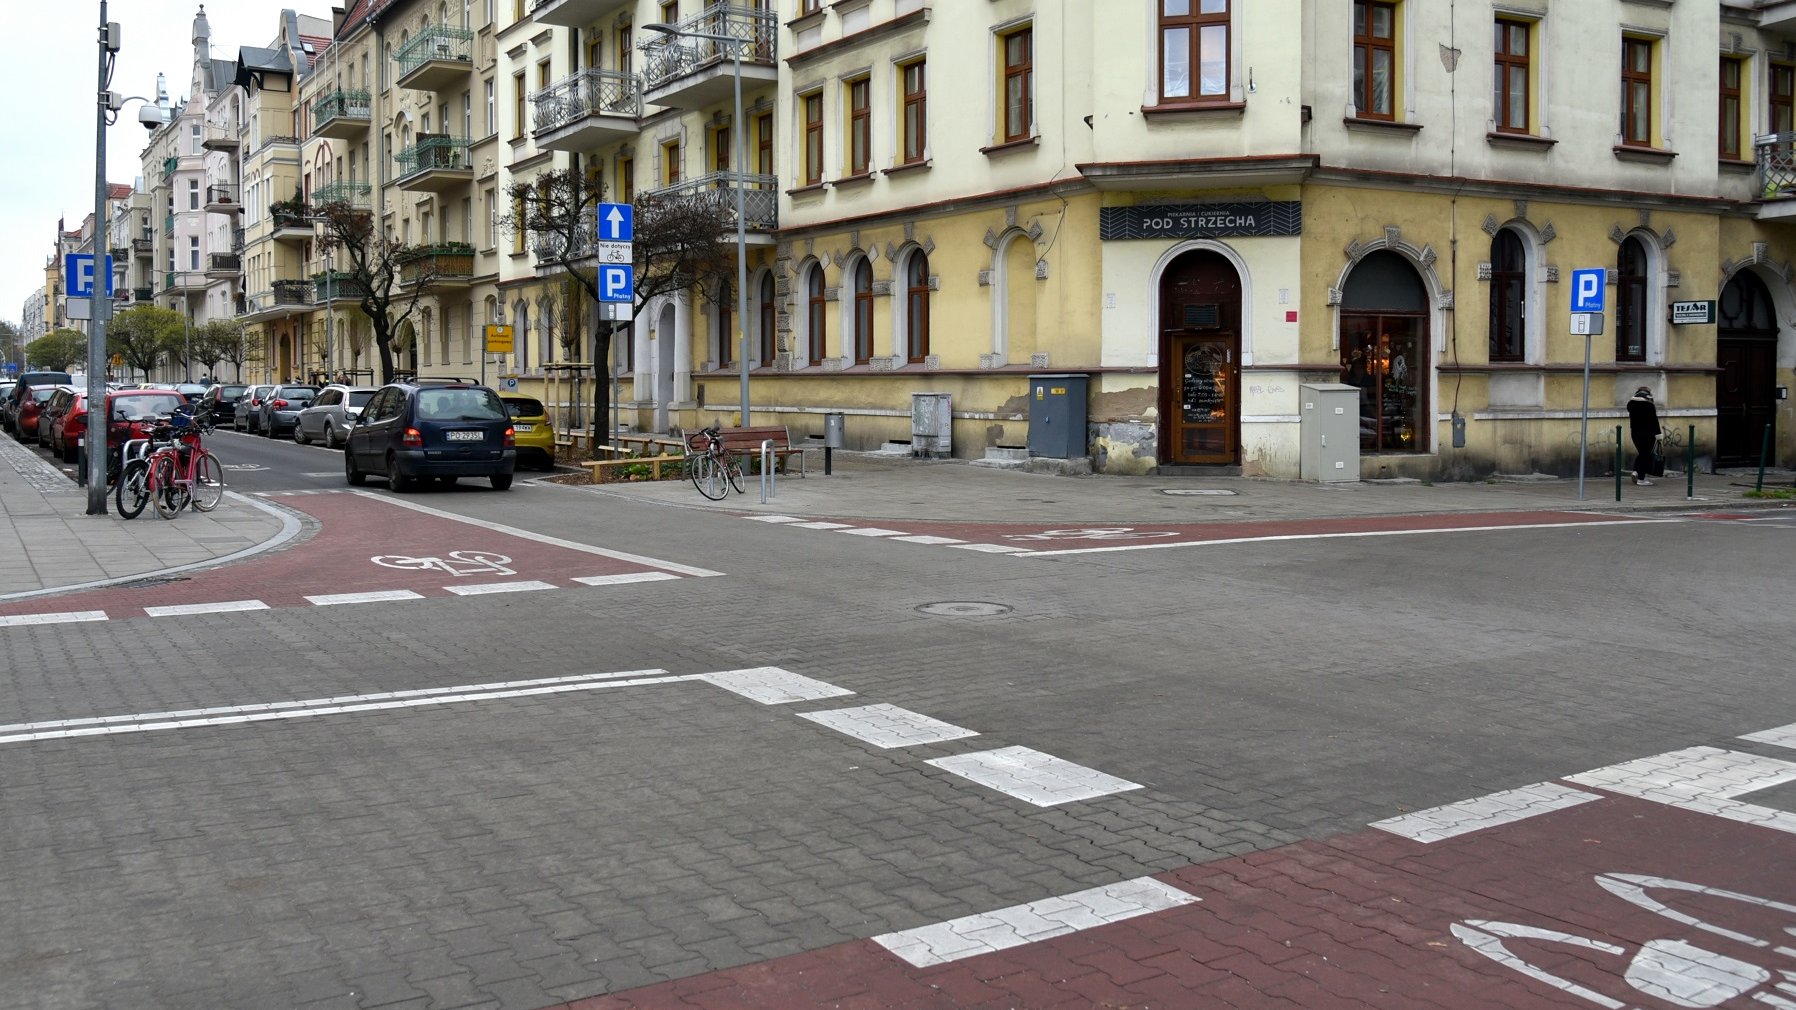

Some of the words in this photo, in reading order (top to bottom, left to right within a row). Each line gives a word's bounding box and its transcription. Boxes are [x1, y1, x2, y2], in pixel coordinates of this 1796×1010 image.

[1143, 218, 1172, 229] POD
[1180, 215, 1256, 228] STRZECHA
[607, 269, 626, 297] P
[1578, 274, 1598, 307] P
[1676, 302, 1706, 312] TESAR
[450, 431, 461, 439] PO
